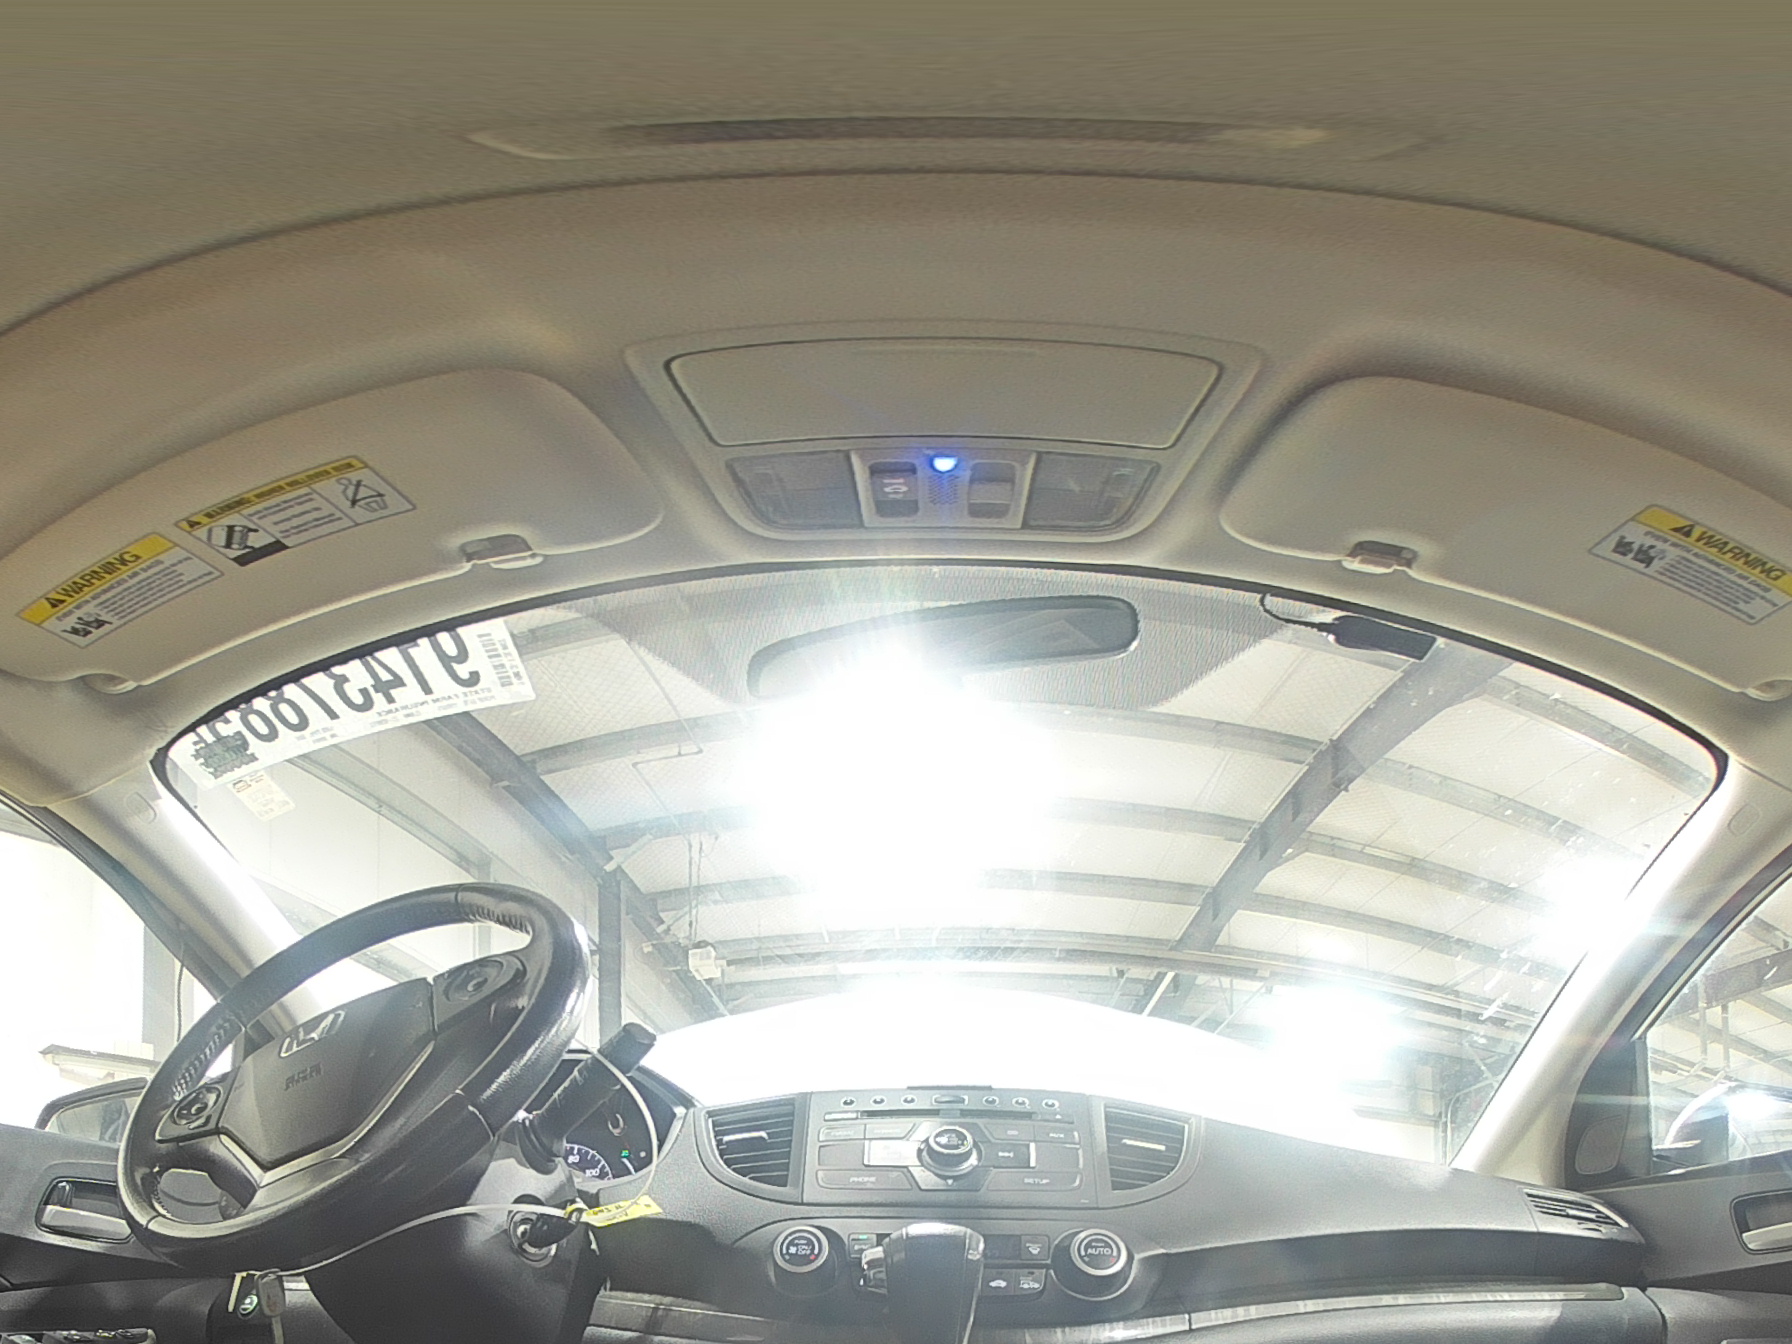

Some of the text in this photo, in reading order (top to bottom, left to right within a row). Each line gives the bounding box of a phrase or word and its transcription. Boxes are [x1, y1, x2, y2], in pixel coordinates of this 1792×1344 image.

[1694, 530, 1787, 581] WARNING
[55, 550, 142, 600] WARNING
[584, 1167, 600, 1177] 100
[849, 1175, 877, 1184] PHONE
[1023, 1177, 1051, 1185] SETUP
[1086, 1247, 1112, 1256] AUTO
